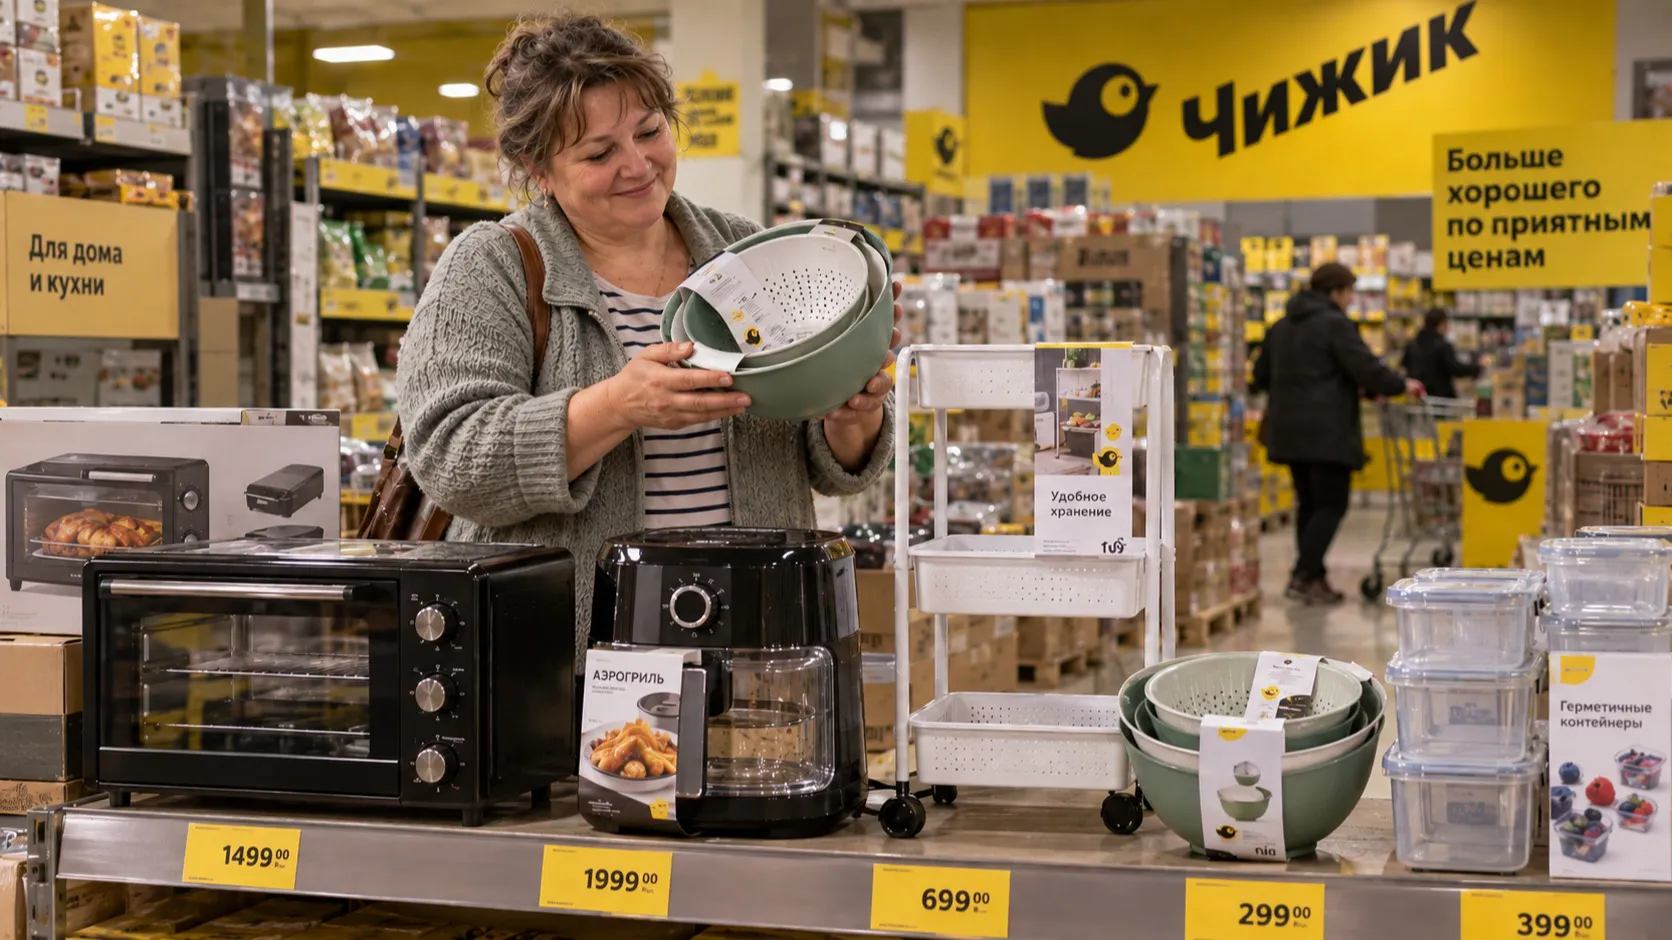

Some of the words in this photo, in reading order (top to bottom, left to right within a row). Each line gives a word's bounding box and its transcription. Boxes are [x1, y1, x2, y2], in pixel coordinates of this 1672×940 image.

[1181, 1, 1479, 158] Чижик
[1447, 148, 1564, 173] Больше
[1448, 179, 1601, 209] хорошего
[1447, 217, 1484, 237] по
[1493, 211, 1651, 242] приятным
[28, 233, 68, 263] Для
[72, 243, 123, 266] дома
[1448, 248, 1545, 274] ценам
[30, 273, 42, 292] и
[47, 274, 105, 301] кухни
[1051, 490, 1107, 504] Удобное
[1051, 507, 1111, 519] хранение
[592, 669, 665, 685] АЭРОГРИЛЬ
[1560, 700, 1653, 715] Герметичные
[1560, 716, 1643, 731] контейнеры
